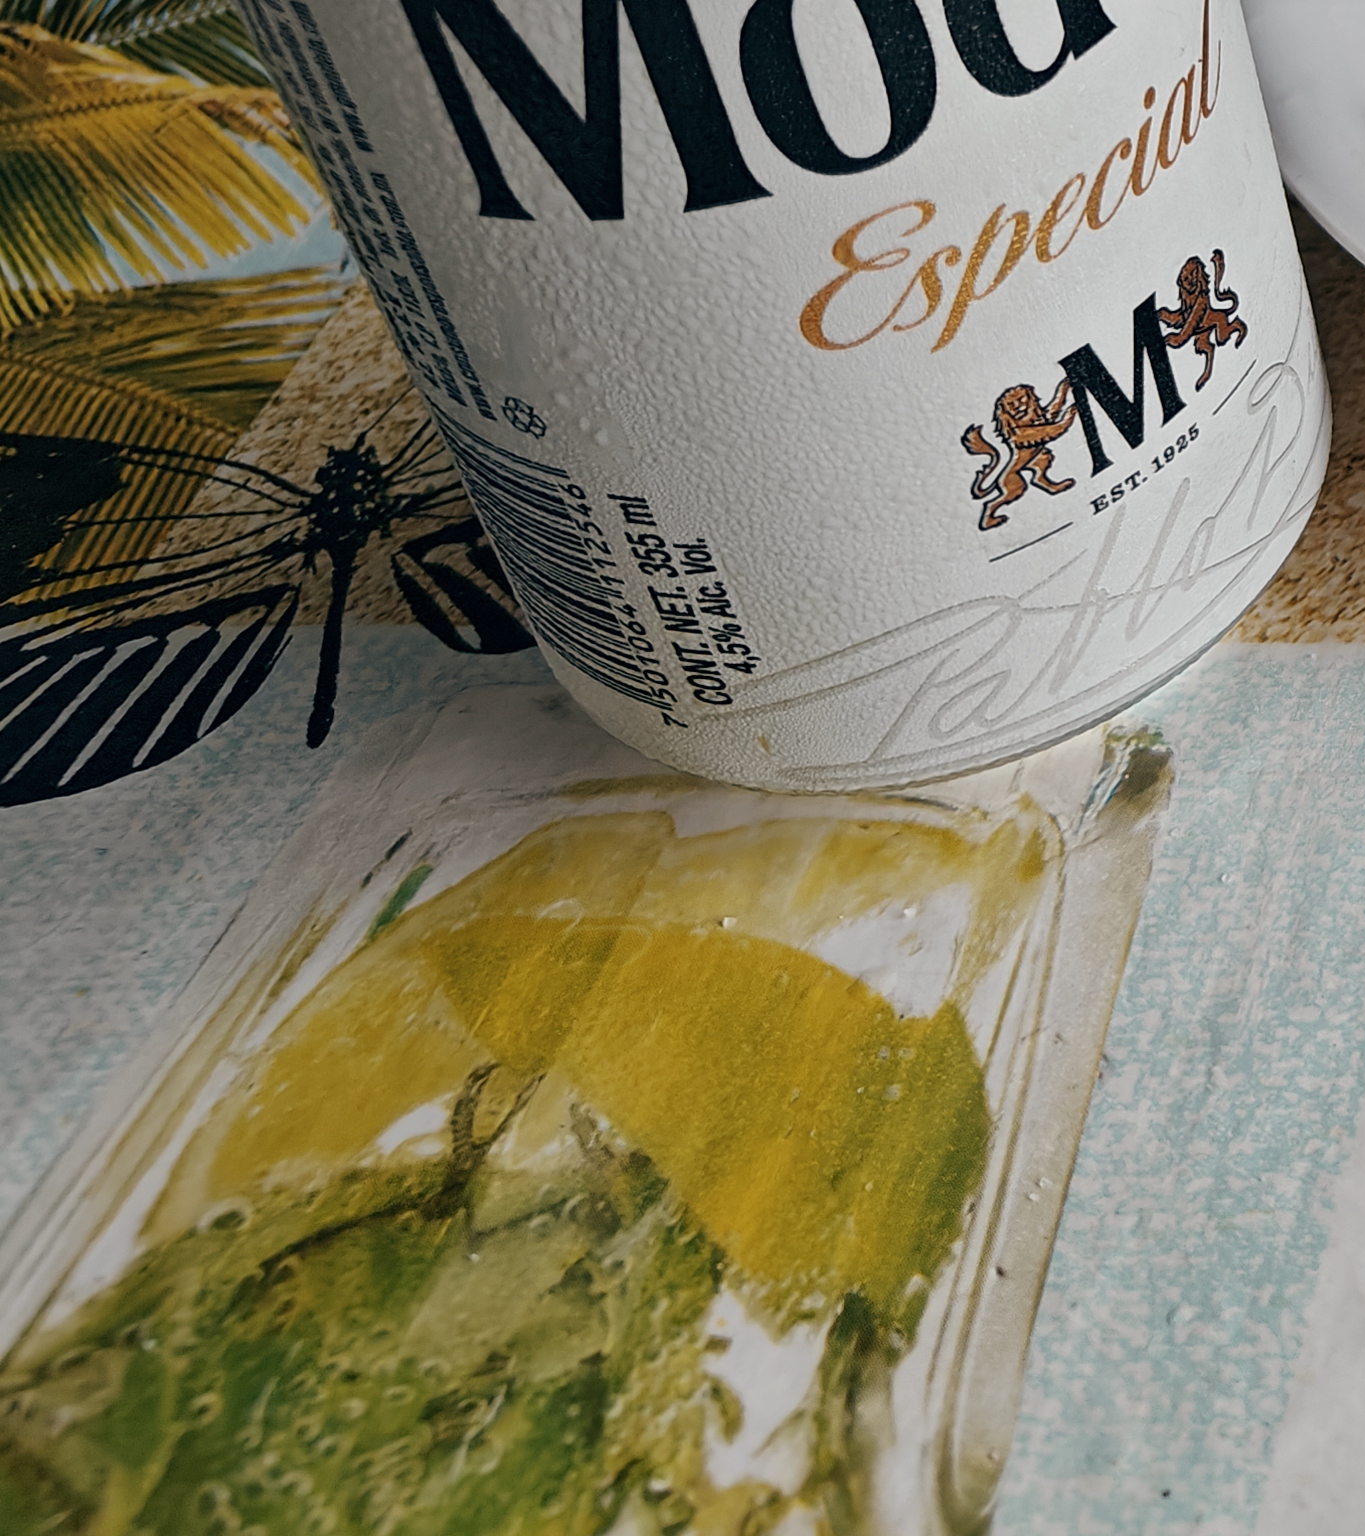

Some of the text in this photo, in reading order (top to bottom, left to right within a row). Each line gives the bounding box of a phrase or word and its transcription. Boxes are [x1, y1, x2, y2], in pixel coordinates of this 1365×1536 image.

[1057, 290, 1189, 479] M
[1089, 421, 1200, 517] EST. 1925
[606, 492, 734, 706] CONT. NET. 355 ml
[672, 537, 763, 675] 4,5% Alc. Vol.
